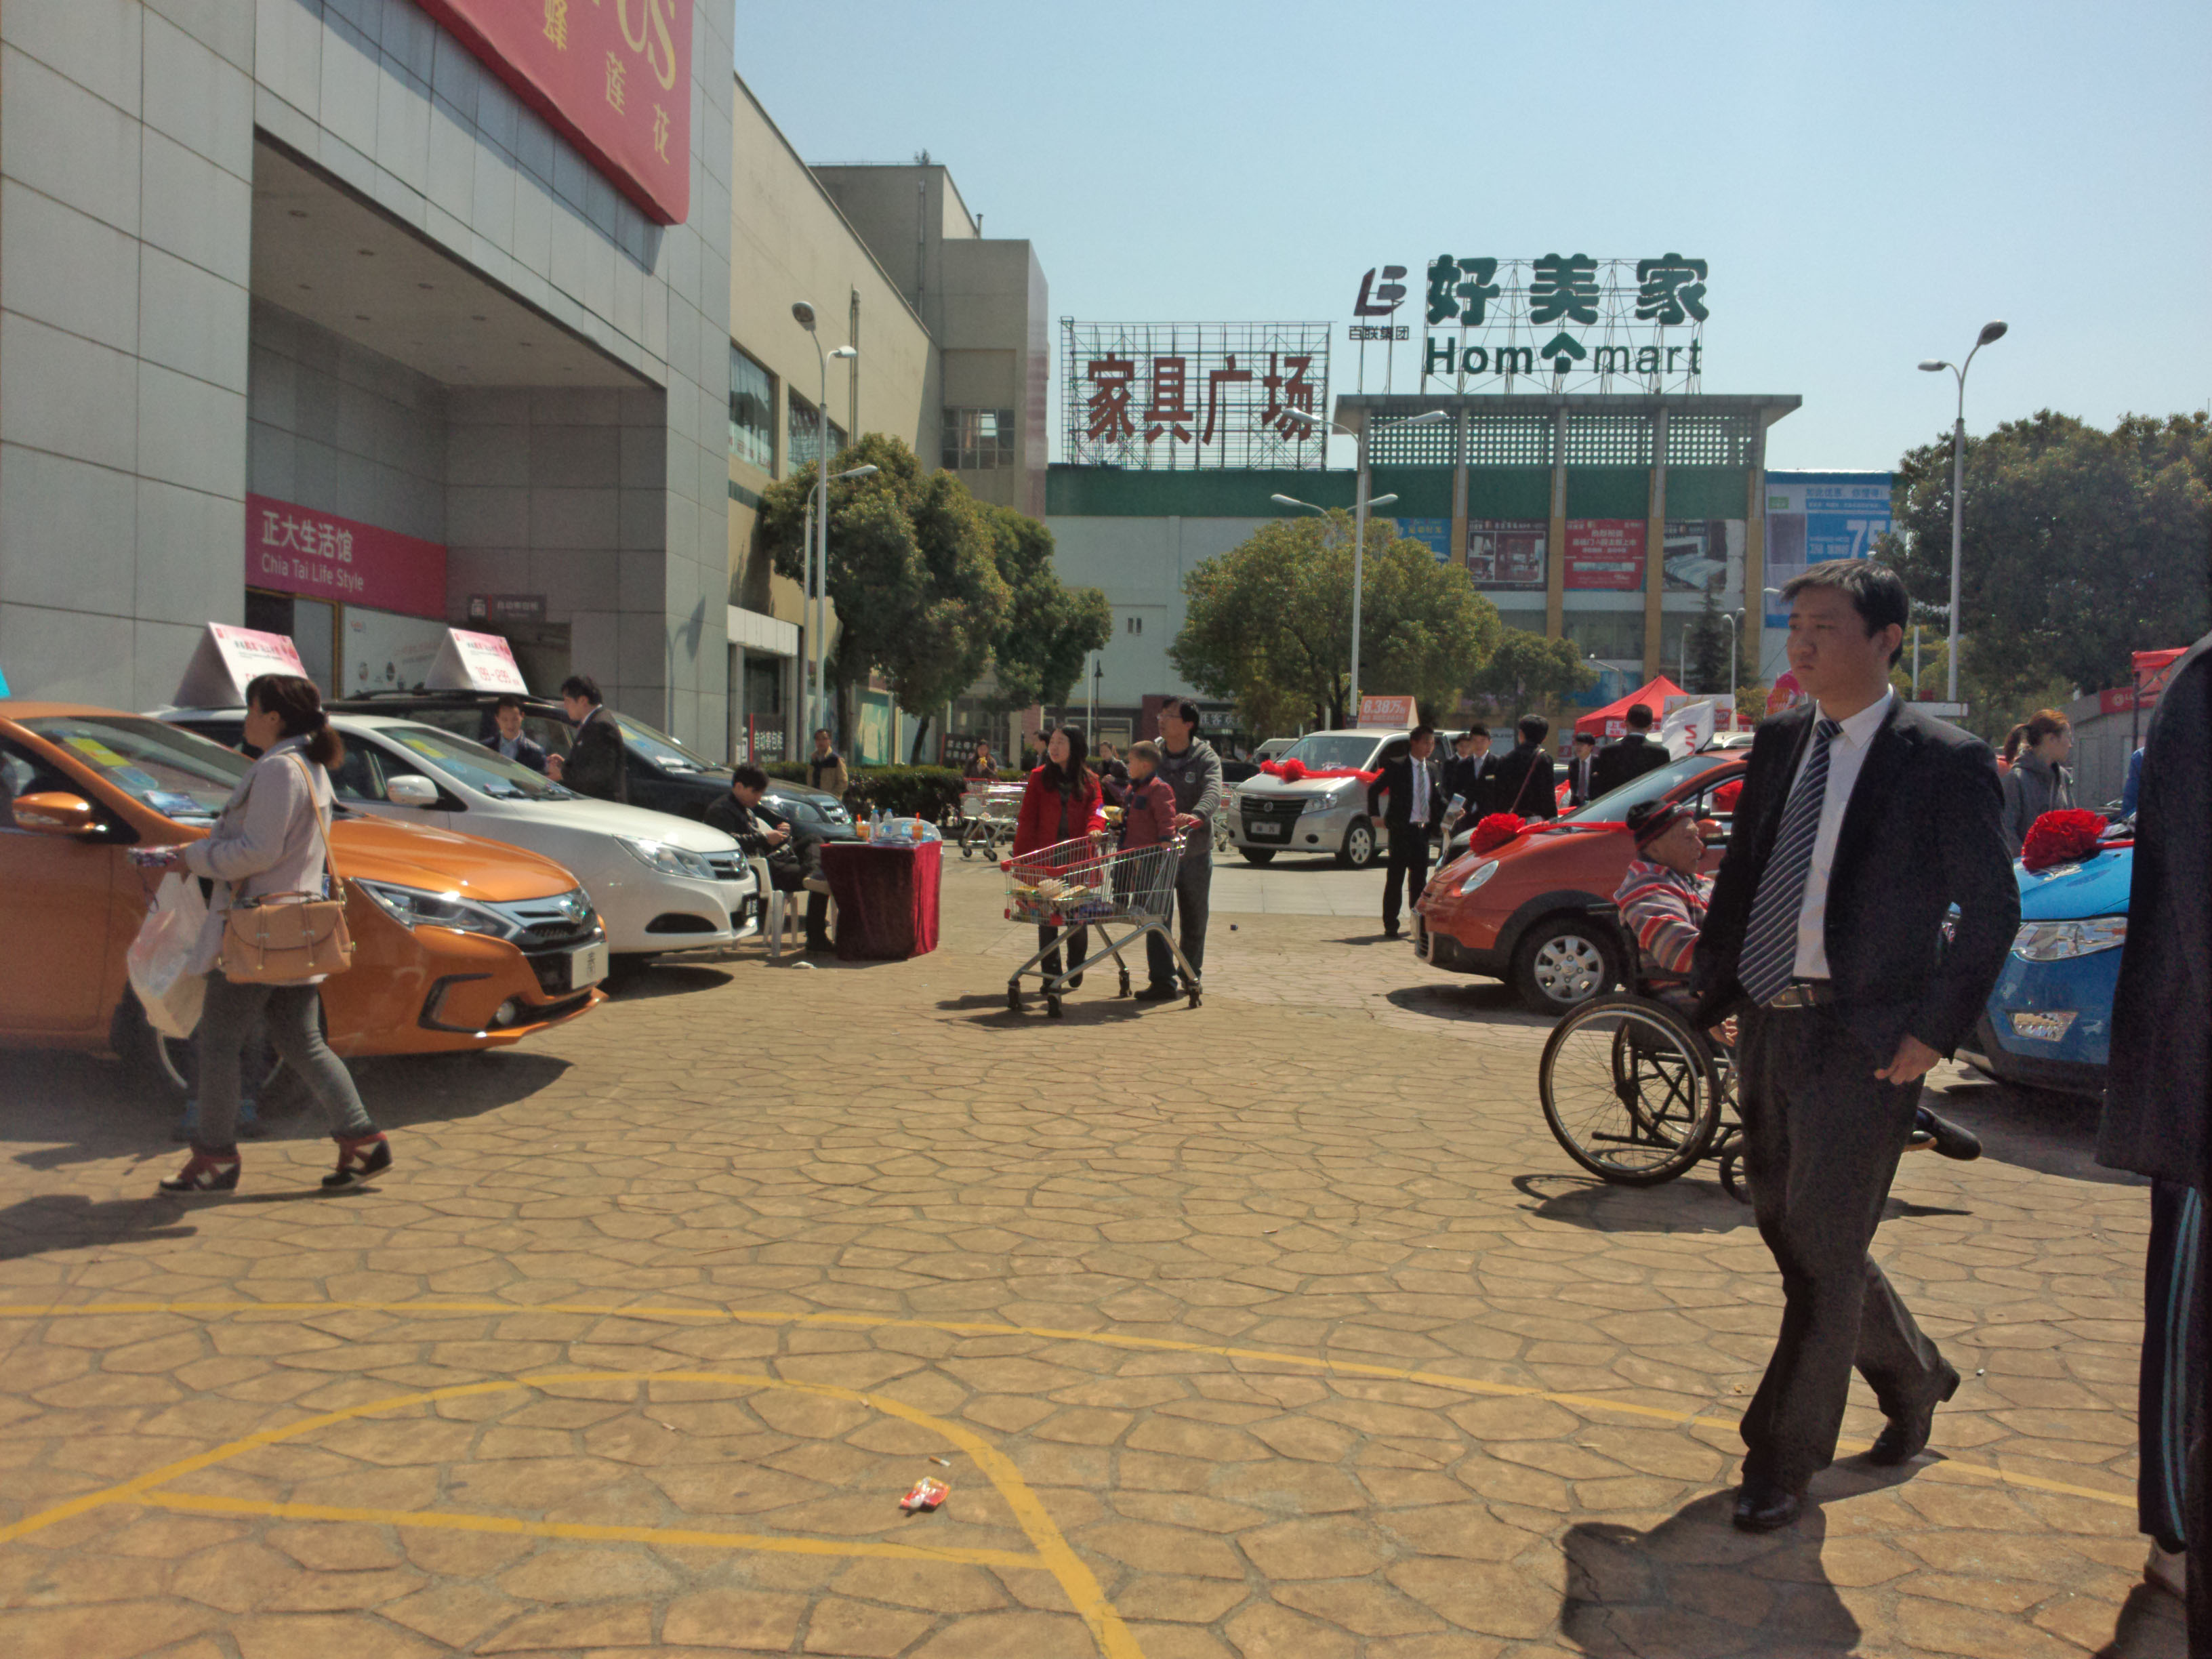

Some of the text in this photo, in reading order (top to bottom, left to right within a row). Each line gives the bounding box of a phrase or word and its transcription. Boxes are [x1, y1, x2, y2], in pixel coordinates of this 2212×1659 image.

[1427, 252, 1710, 325] 好美家
[1349, 325, 1410, 341] 百联集团
[1086, 352, 1315, 446] 家具广场
[262, 511, 353, 563] 正大生活馆
[262, 554, 364, 593] Chia Tai Life Style
[754, 731, 783, 750] 自动寄包柜
